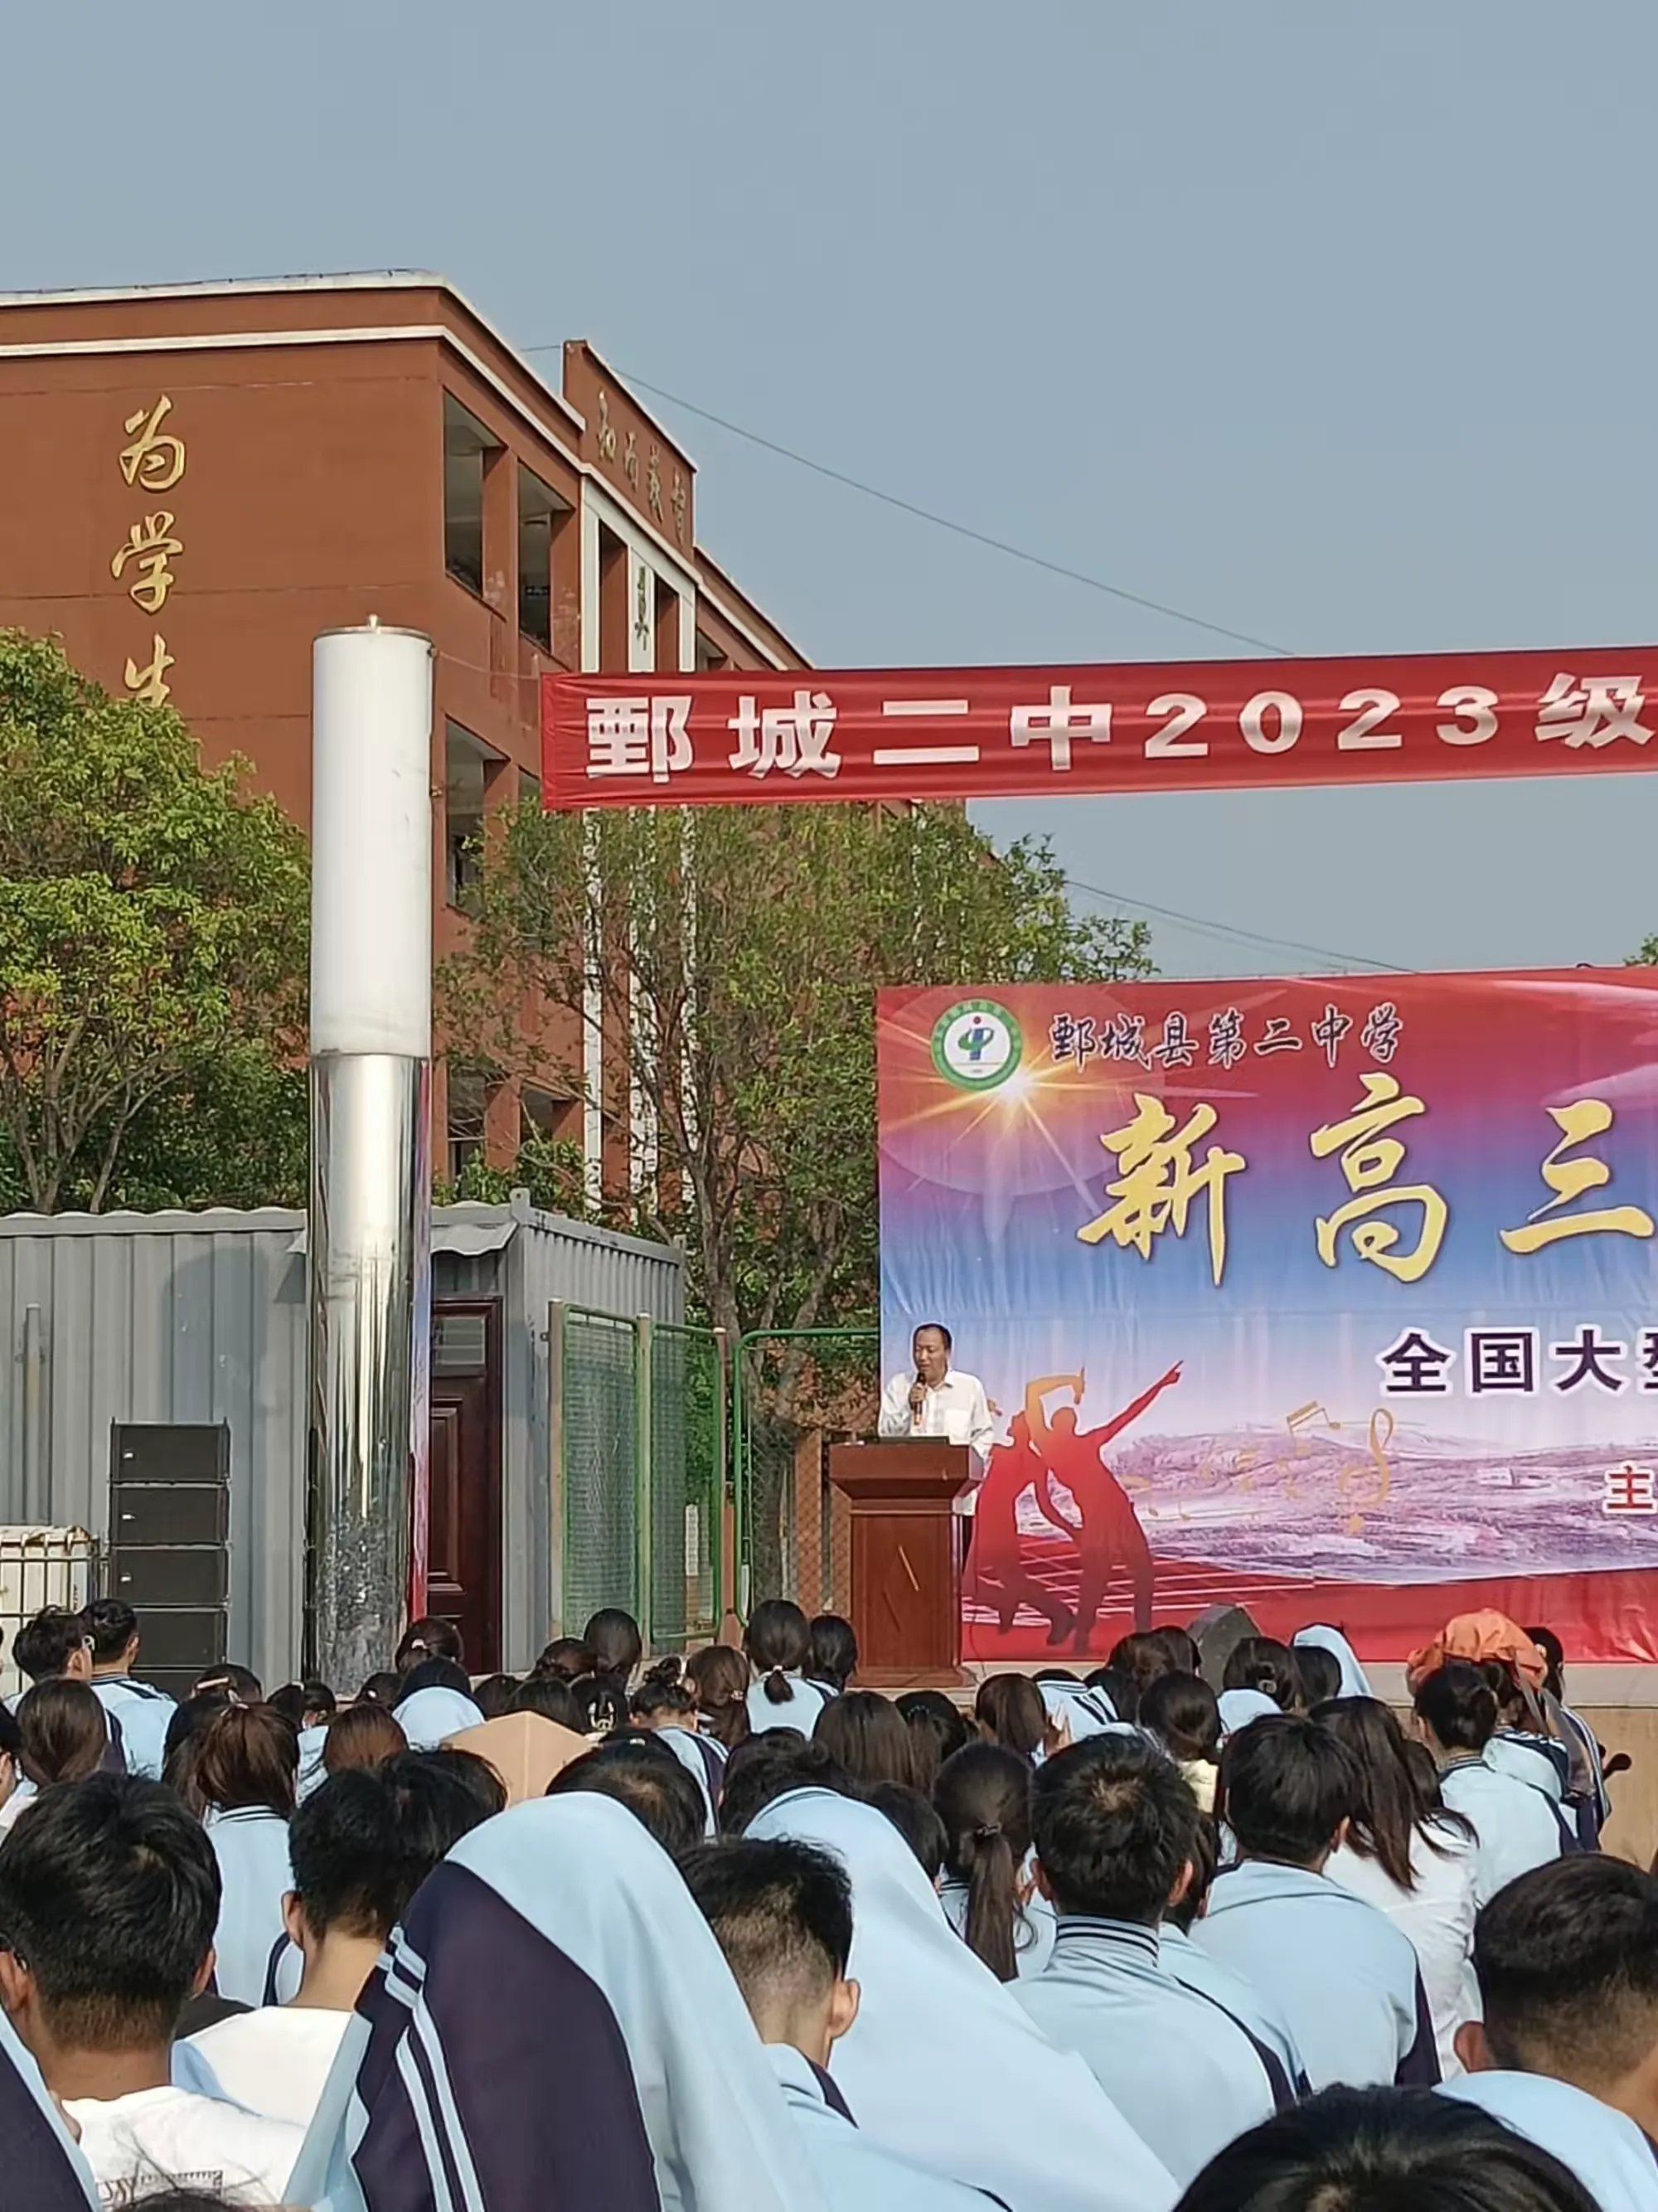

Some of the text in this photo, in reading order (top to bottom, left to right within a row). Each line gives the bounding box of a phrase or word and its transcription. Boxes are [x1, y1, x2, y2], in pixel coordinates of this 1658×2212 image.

[111, 395, 187, 709] 为学生
[585, 672, 1656, 783] 鄄城二中2023级
[1050, 1001, 1403, 1072] 鄄城县第二中学
[1077, 1072, 1655, 1287] 新高三
[1382, 1329, 1658, 1393] 全国大
